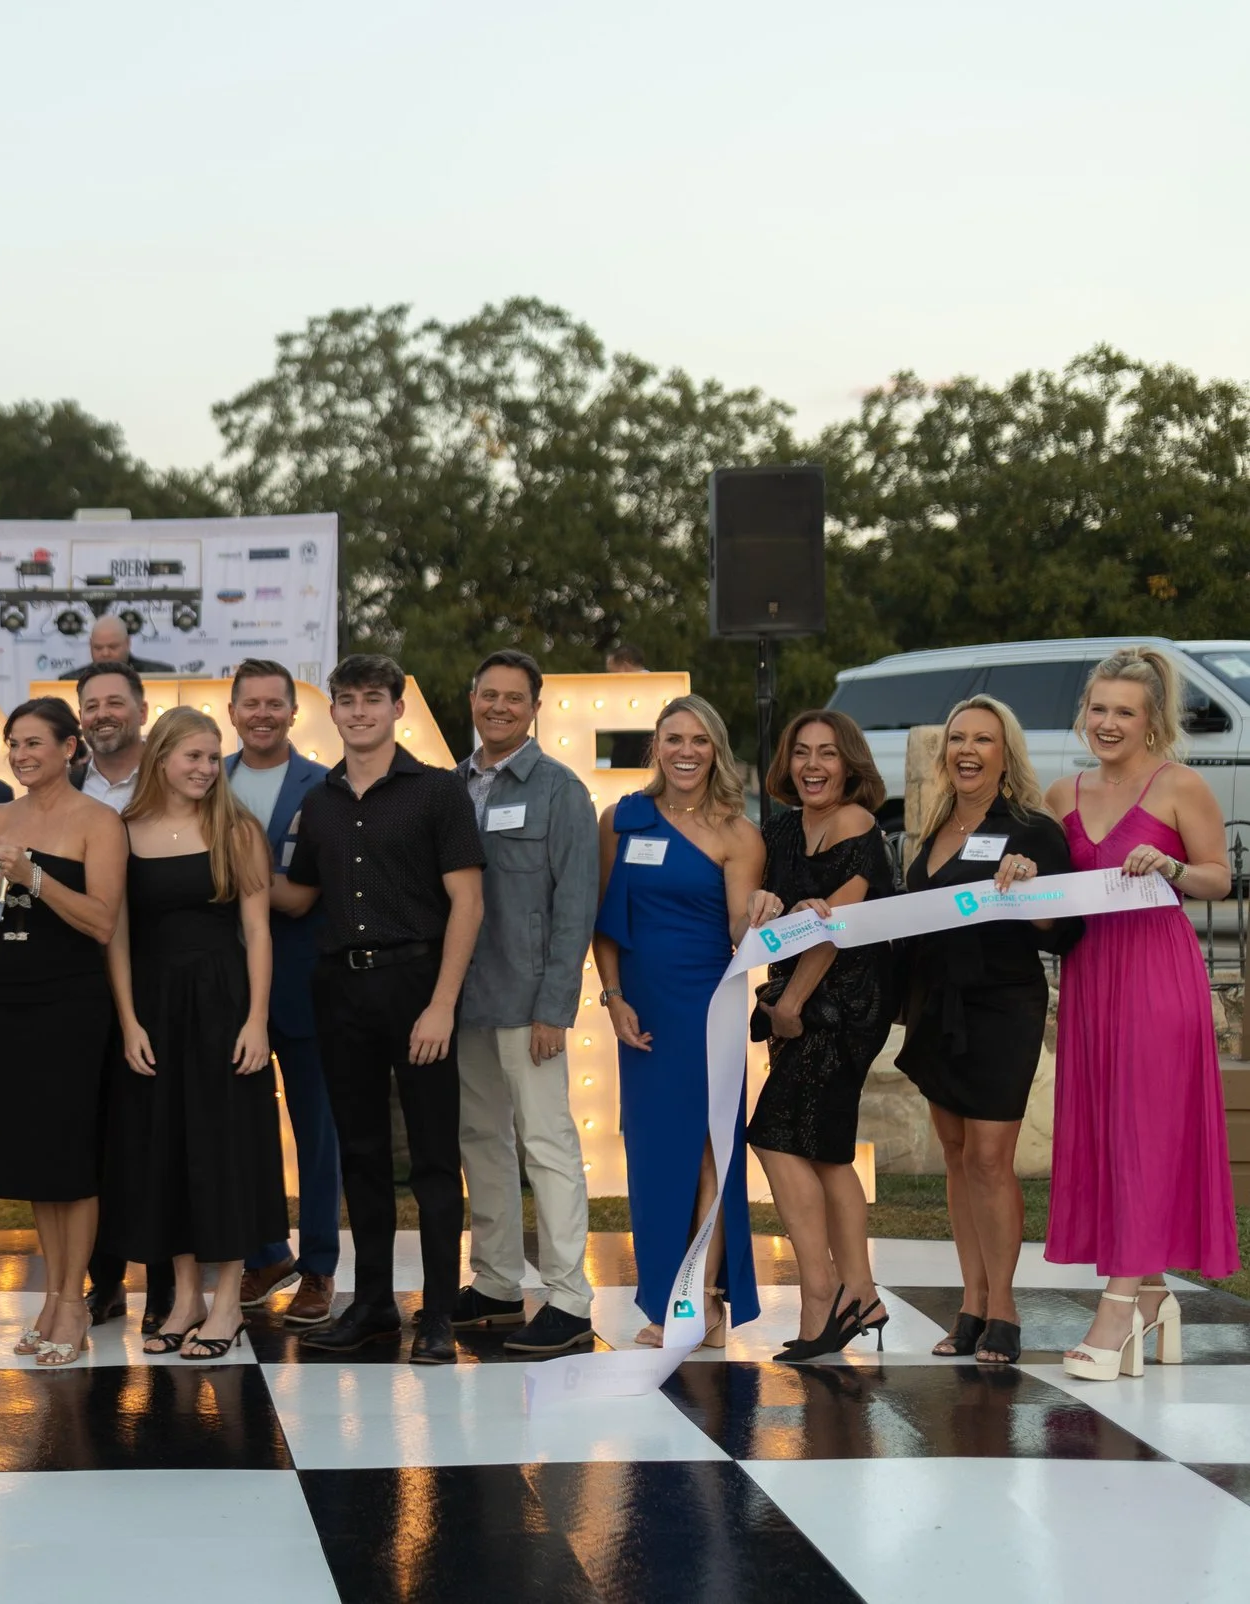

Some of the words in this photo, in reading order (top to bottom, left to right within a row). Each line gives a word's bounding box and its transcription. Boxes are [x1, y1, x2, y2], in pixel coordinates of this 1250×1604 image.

[111, 559, 151, 577] BOERN
[980, 893, 1016, 904] BOERNE
[1017, 889, 1065, 902] CHAMBER
[780, 922, 814, 941] BOERNE
[681, 1261, 694, 1297] BOERNE
[691, 1222, 713, 1260] CHAMBER
